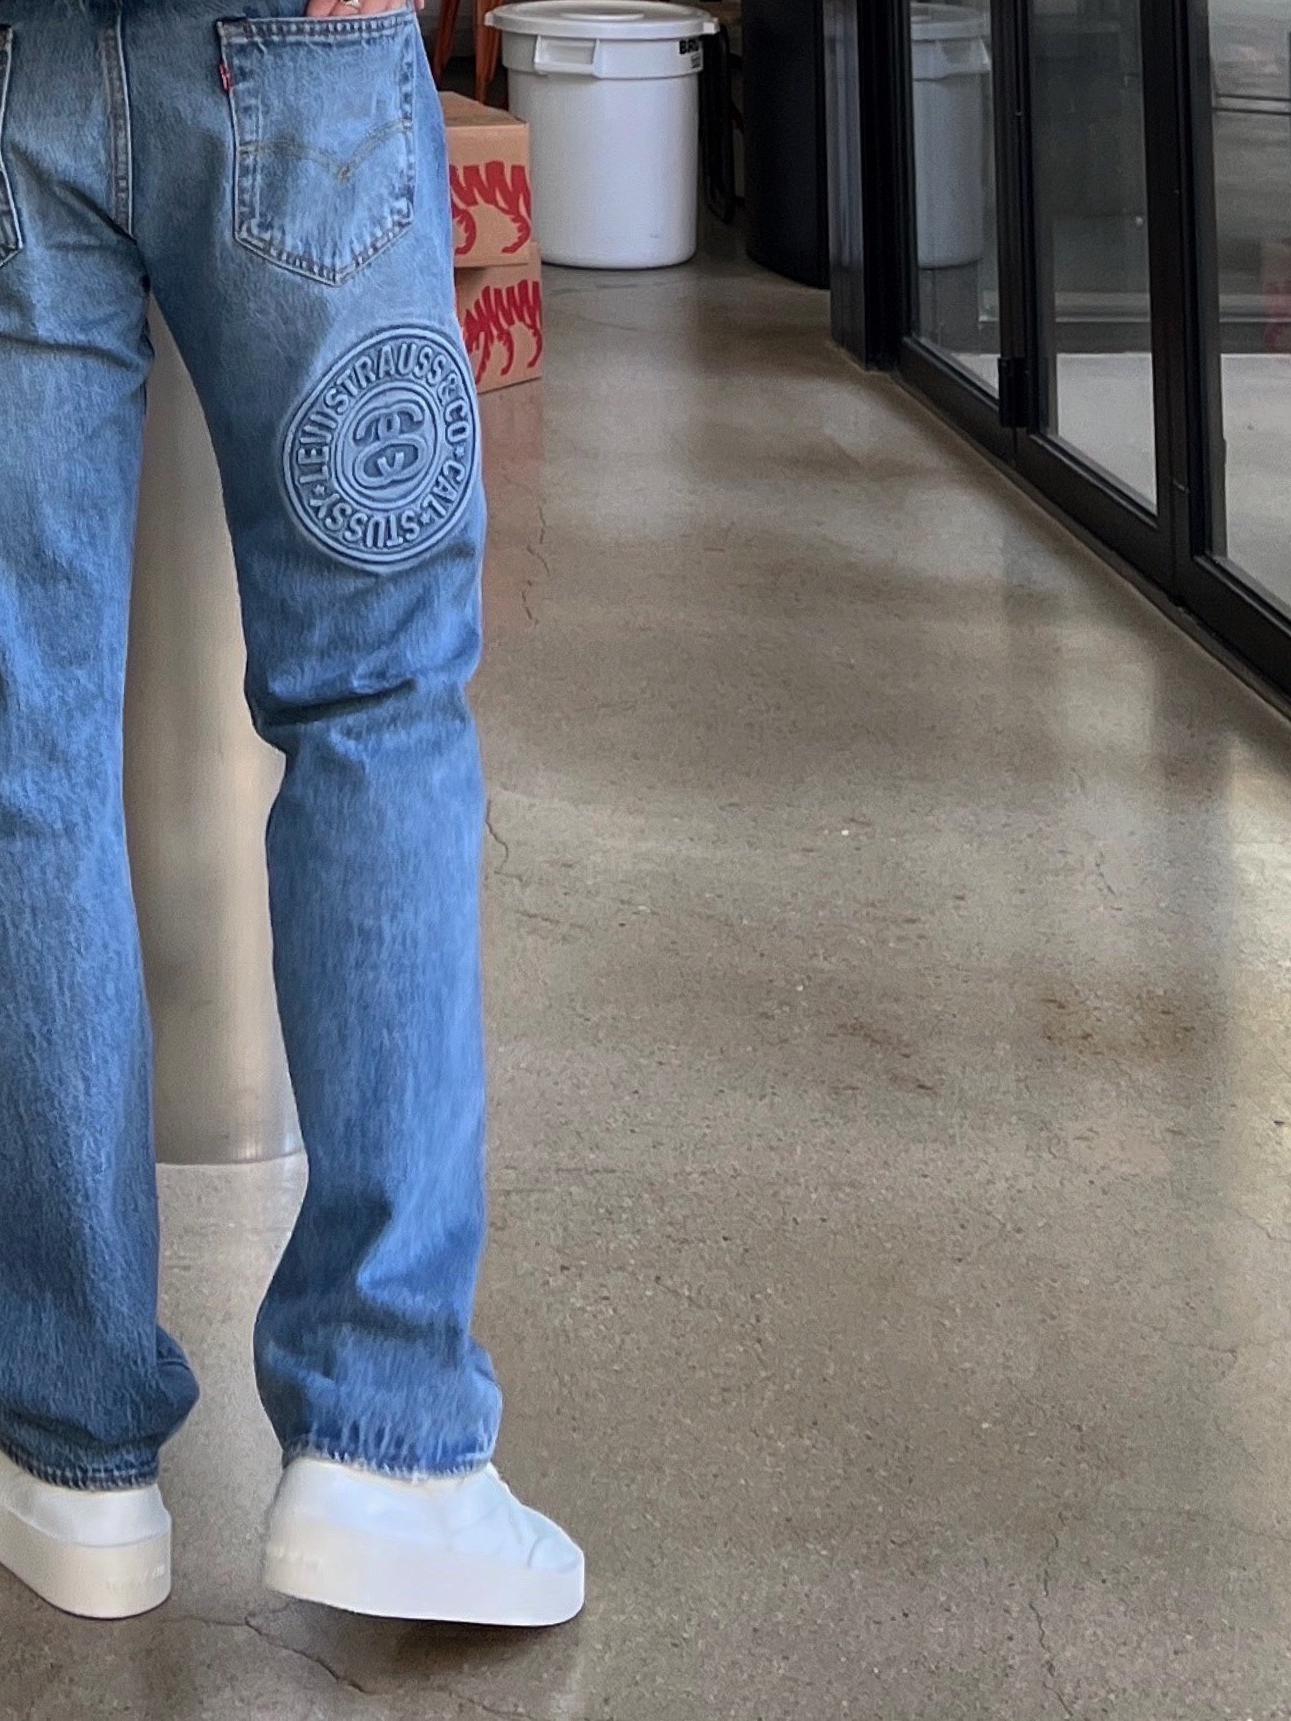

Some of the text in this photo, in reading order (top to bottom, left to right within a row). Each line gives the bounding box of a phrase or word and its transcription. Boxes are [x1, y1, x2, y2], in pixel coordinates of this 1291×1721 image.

[323, 342, 447, 415] STRAUSS
[297, 412, 338, 484] LEVI
[309, 492, 420, 548] STUSSY
[420, 459, 466, 519] CAL
